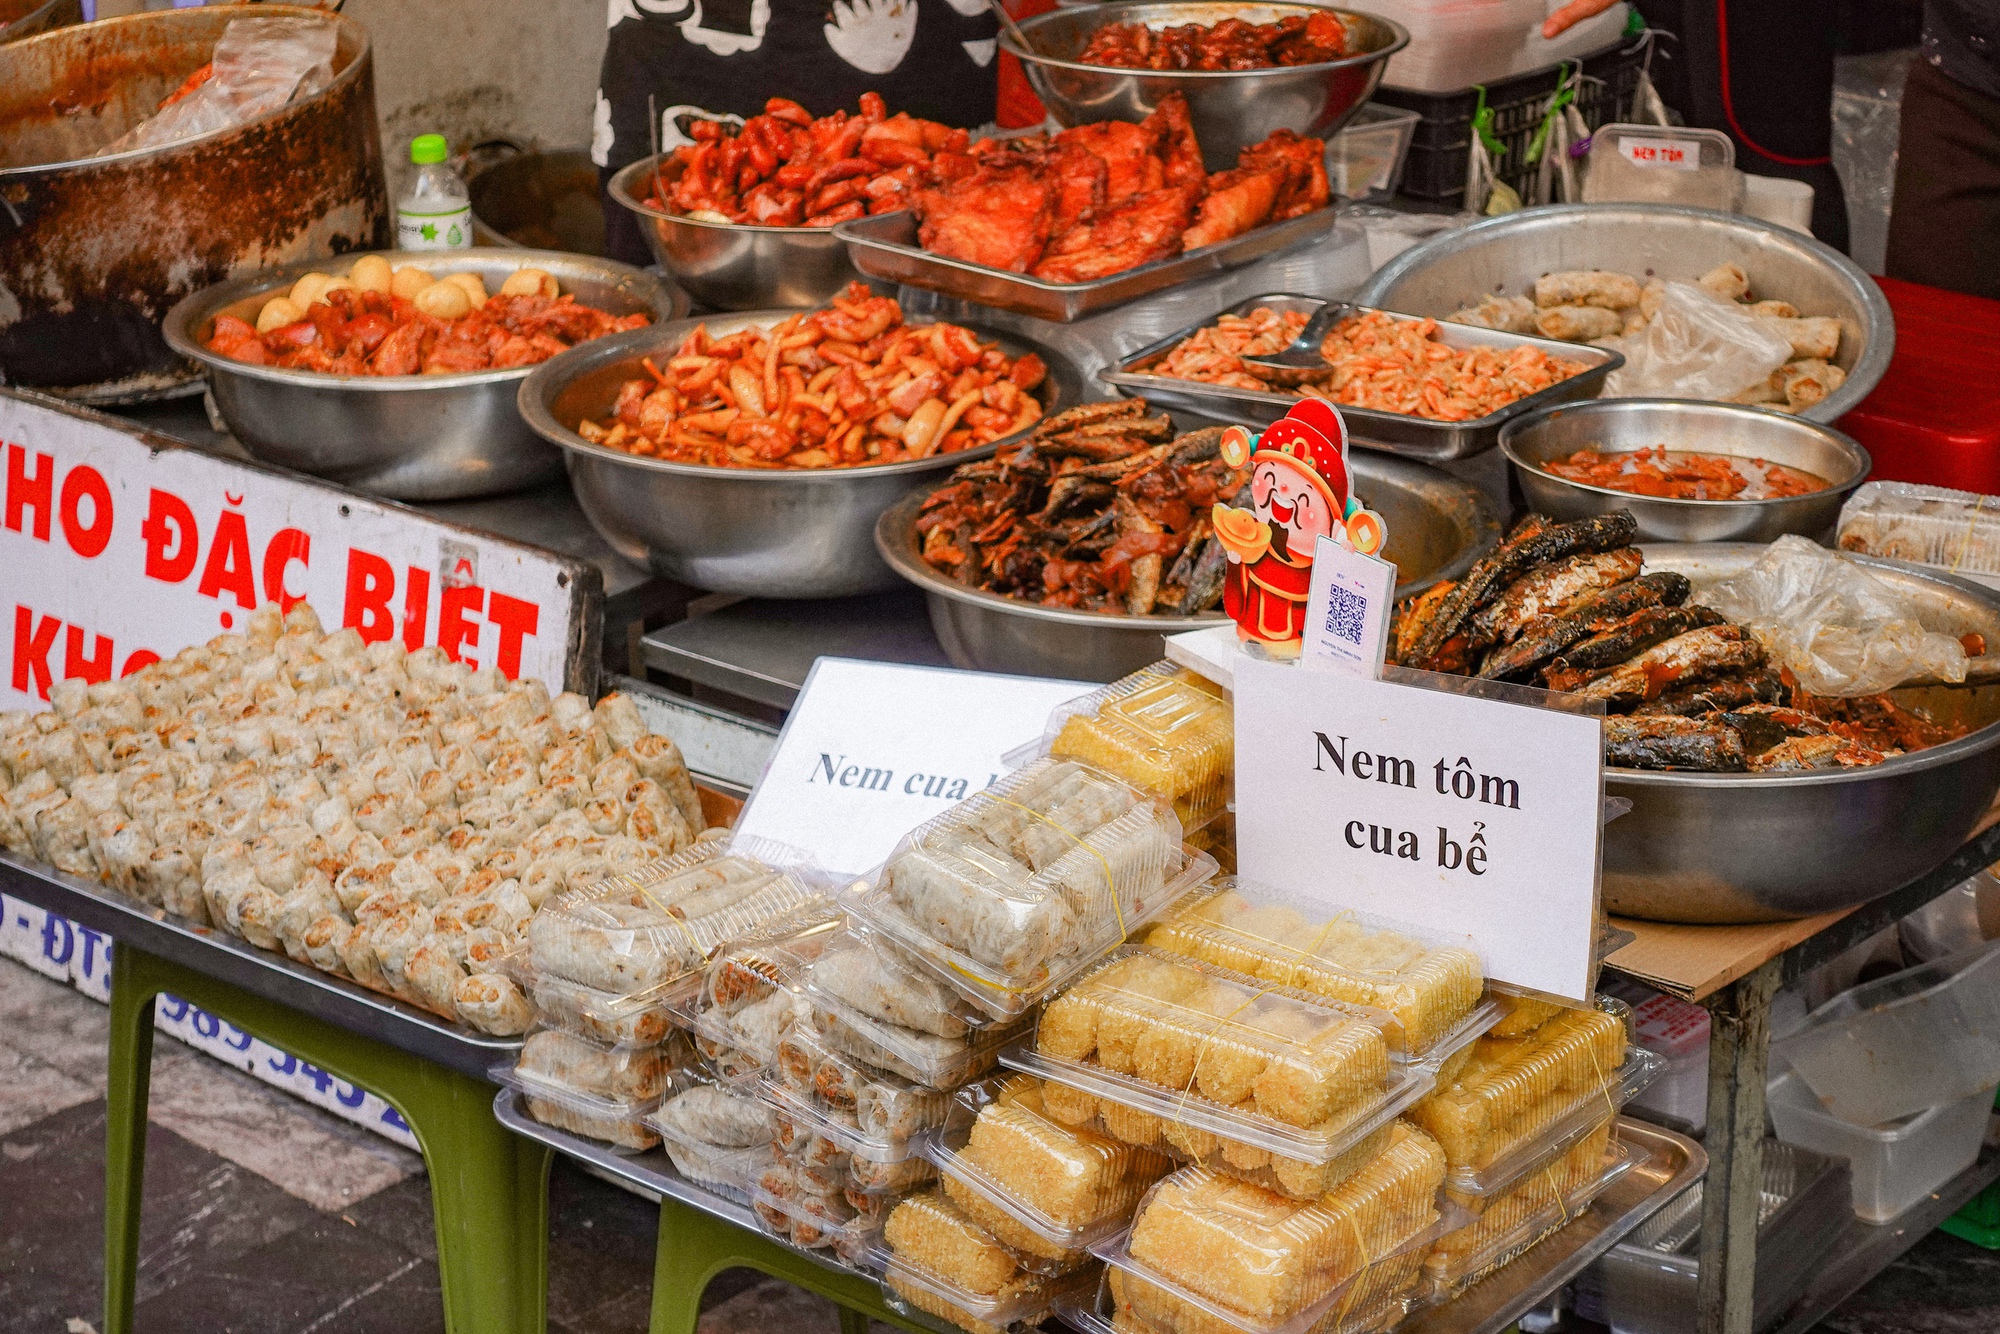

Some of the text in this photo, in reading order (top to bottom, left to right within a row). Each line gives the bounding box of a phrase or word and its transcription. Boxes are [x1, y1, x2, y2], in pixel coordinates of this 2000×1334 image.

[0, 438, 114, 558] HO
[142, 488, 311, 629] ĐẶC
[12, 603, 162, 703] KH
[806, 752, 894, 792] Nem
[904, 773, 968, 800] cua
[1312, 731, 1521, 810] Nem tôm
[1344, 820, 1488, 876] cua bể
